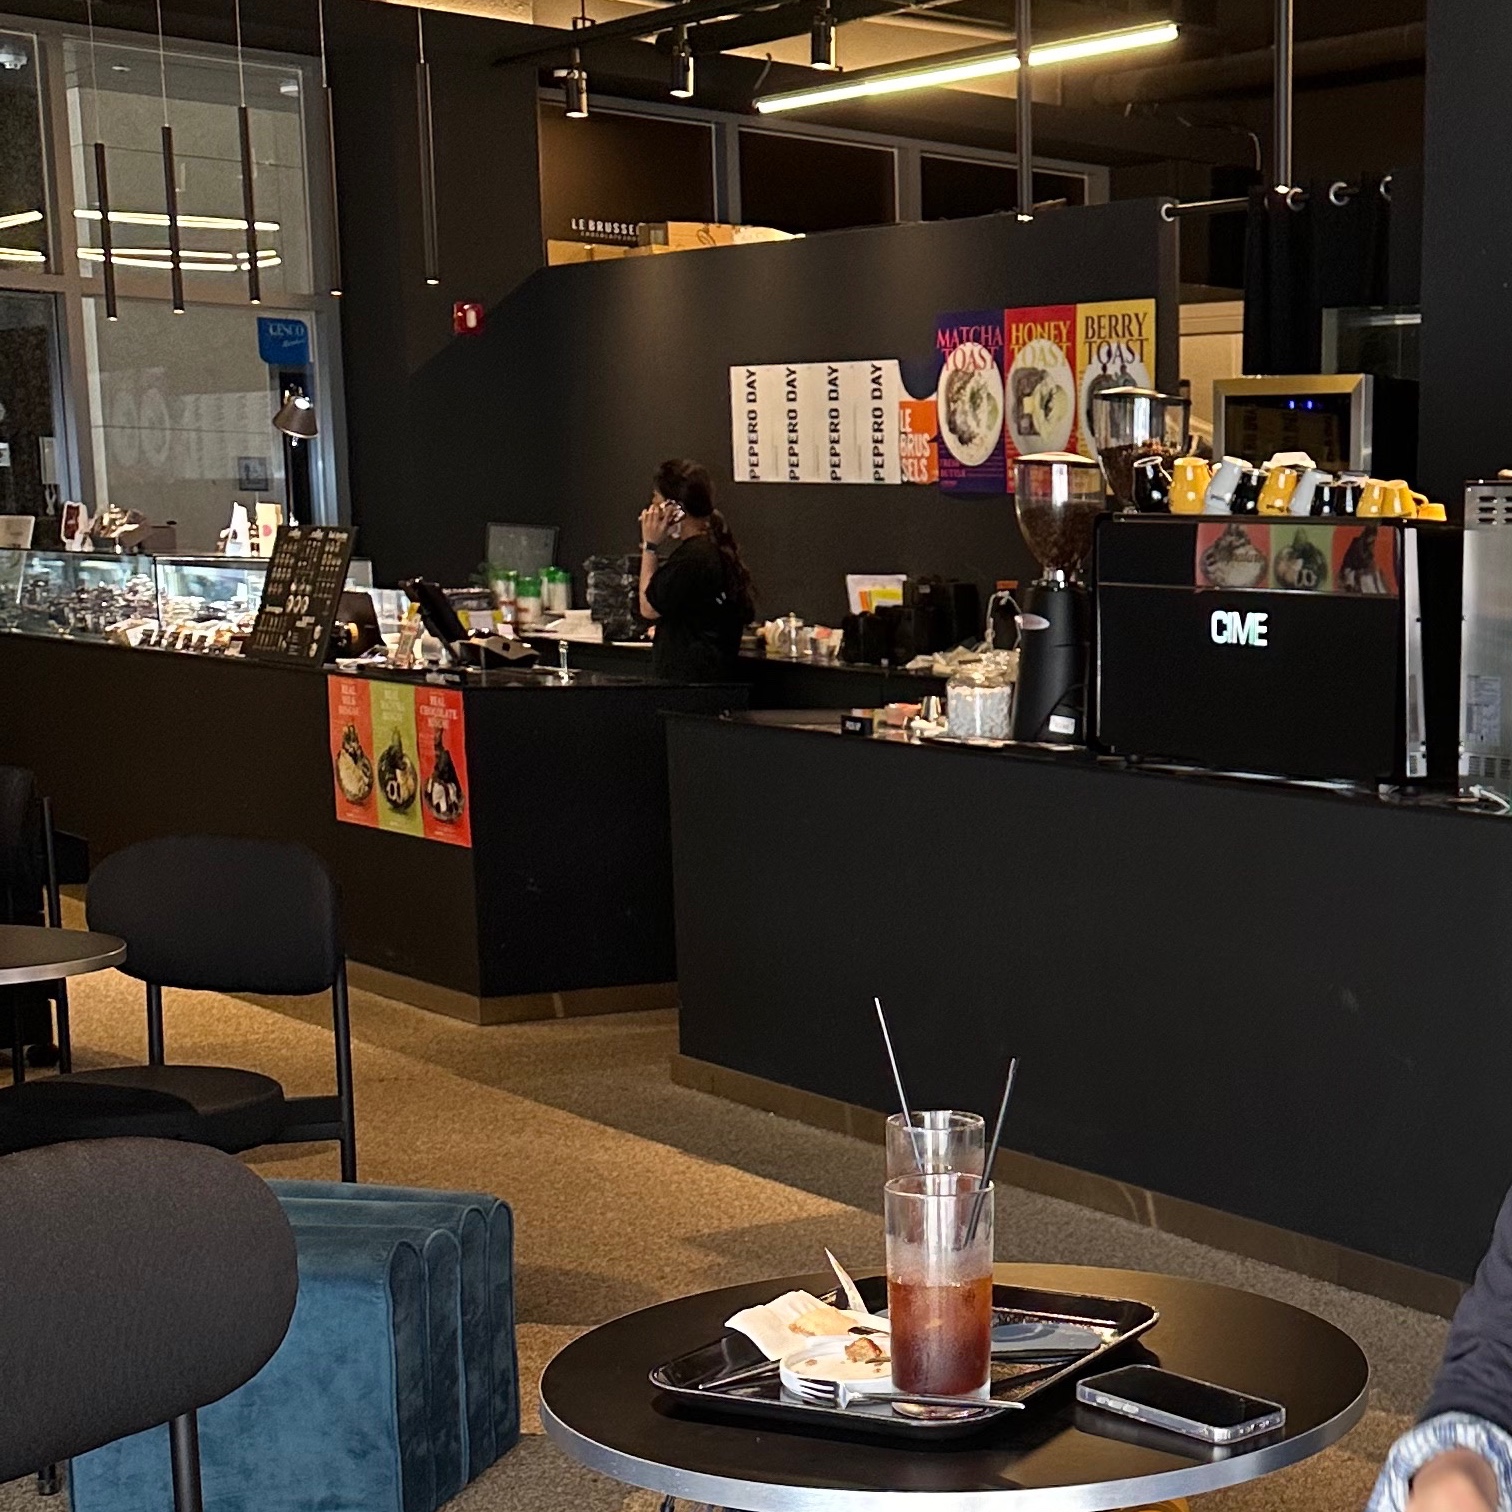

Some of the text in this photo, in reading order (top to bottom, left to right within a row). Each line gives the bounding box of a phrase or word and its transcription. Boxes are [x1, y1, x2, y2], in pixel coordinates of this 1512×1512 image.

[571, 218, 585, 231] LE
[936, 325, 1004, 349] MATCHA
[1011, 320, 1071, 344] HONEY
[1085, 312, 1149, 341] BERRY
[942, 345, 1000, 372] TOAST
[1011, 343, 1071, 369] TOAST
[1085, 337, 1150, 365] TOAST
[745, 368, 760, 481] PEPERO DAY
[785, 366, 800, 482] PEPERO DAY
[826, 365, 842, 482] PEPERO DAY
[870, 363, 885, 482] PEPERO DAY
[900, 408, 912, 433] LE
[1210, 610, 1269, 647] CIME
